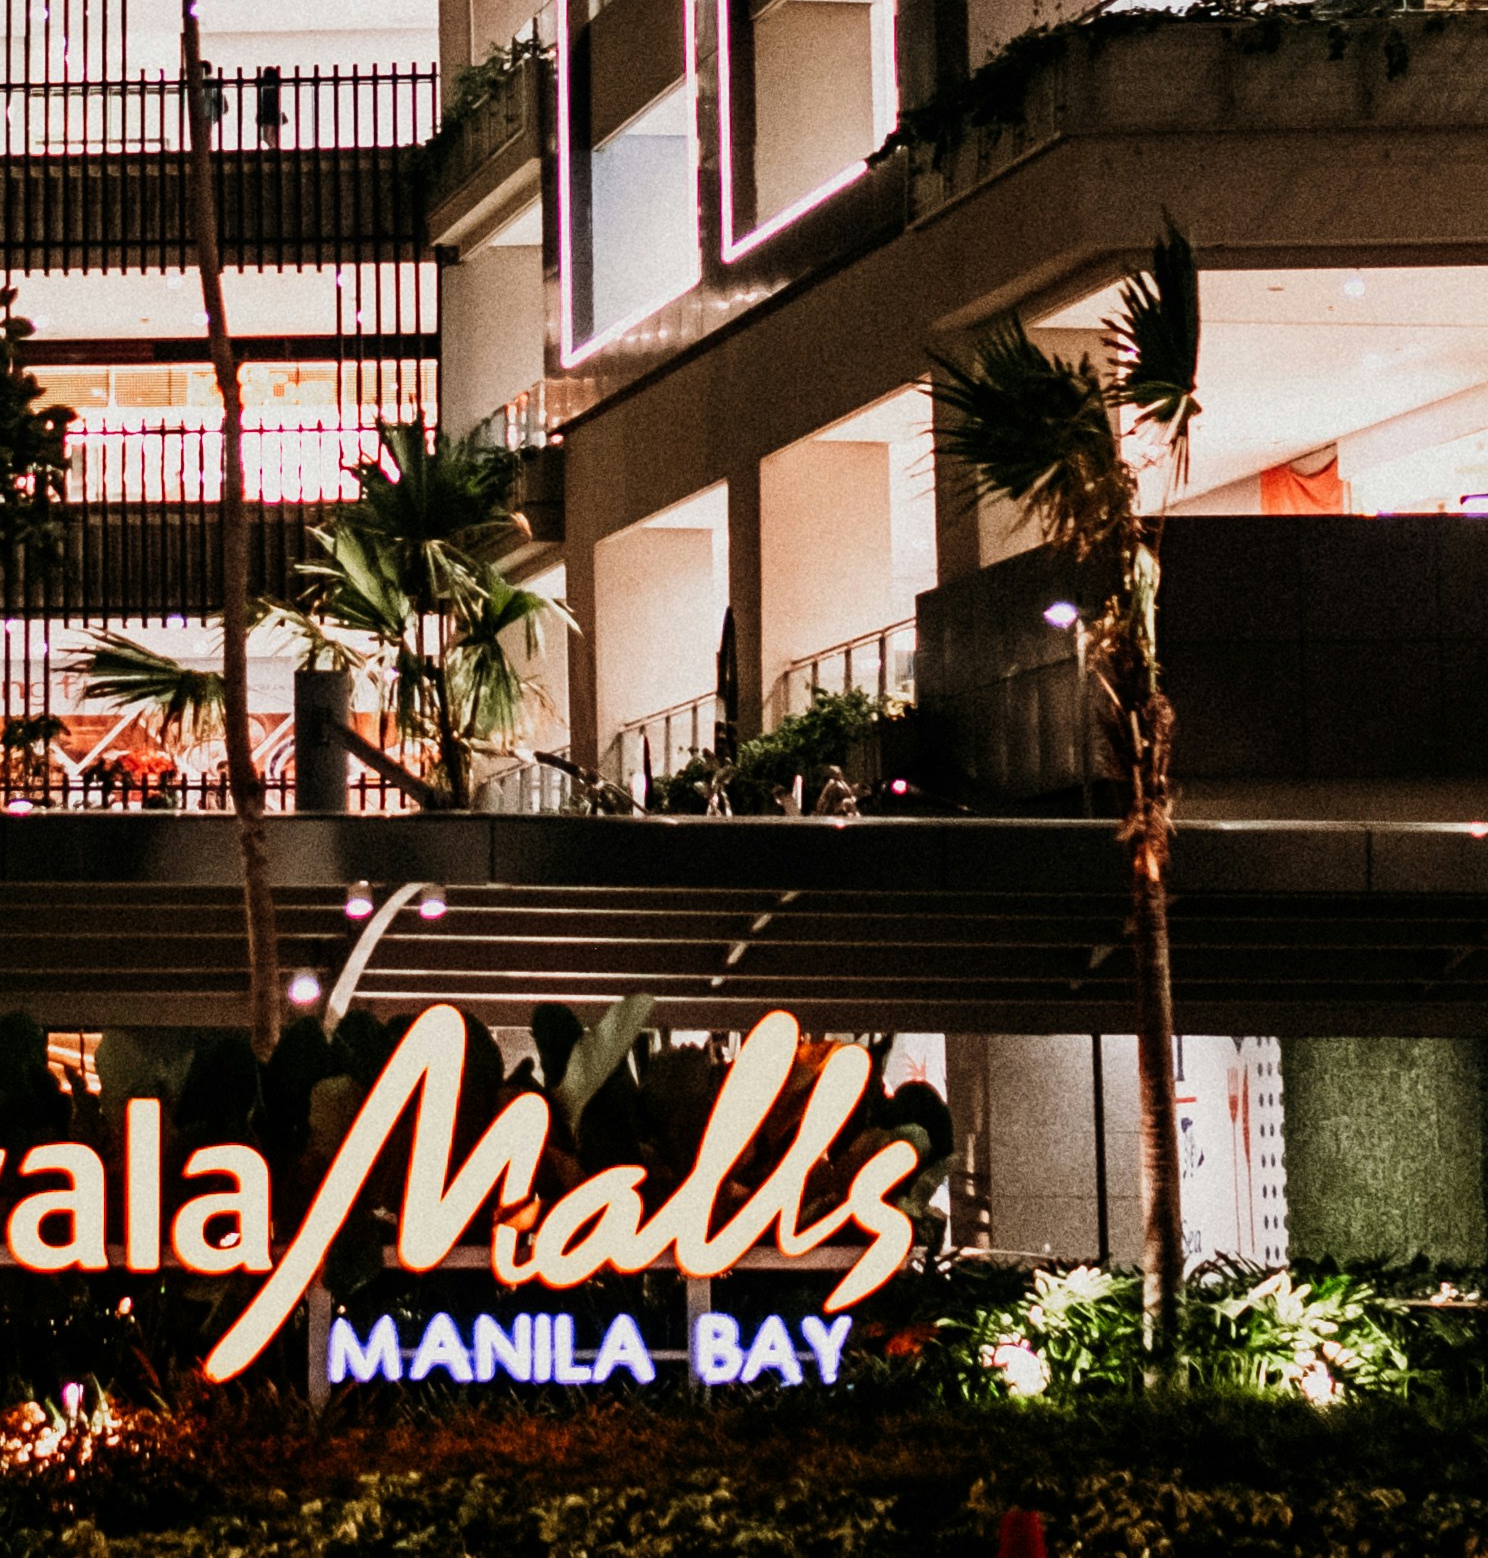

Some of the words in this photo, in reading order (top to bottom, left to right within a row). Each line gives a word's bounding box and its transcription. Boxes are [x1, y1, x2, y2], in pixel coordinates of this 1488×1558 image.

[203, 1001, 919, 1385] Malls
[326, 1311, 655, 1385] MANILA
[687, 1310, 854, 1385] BAY
